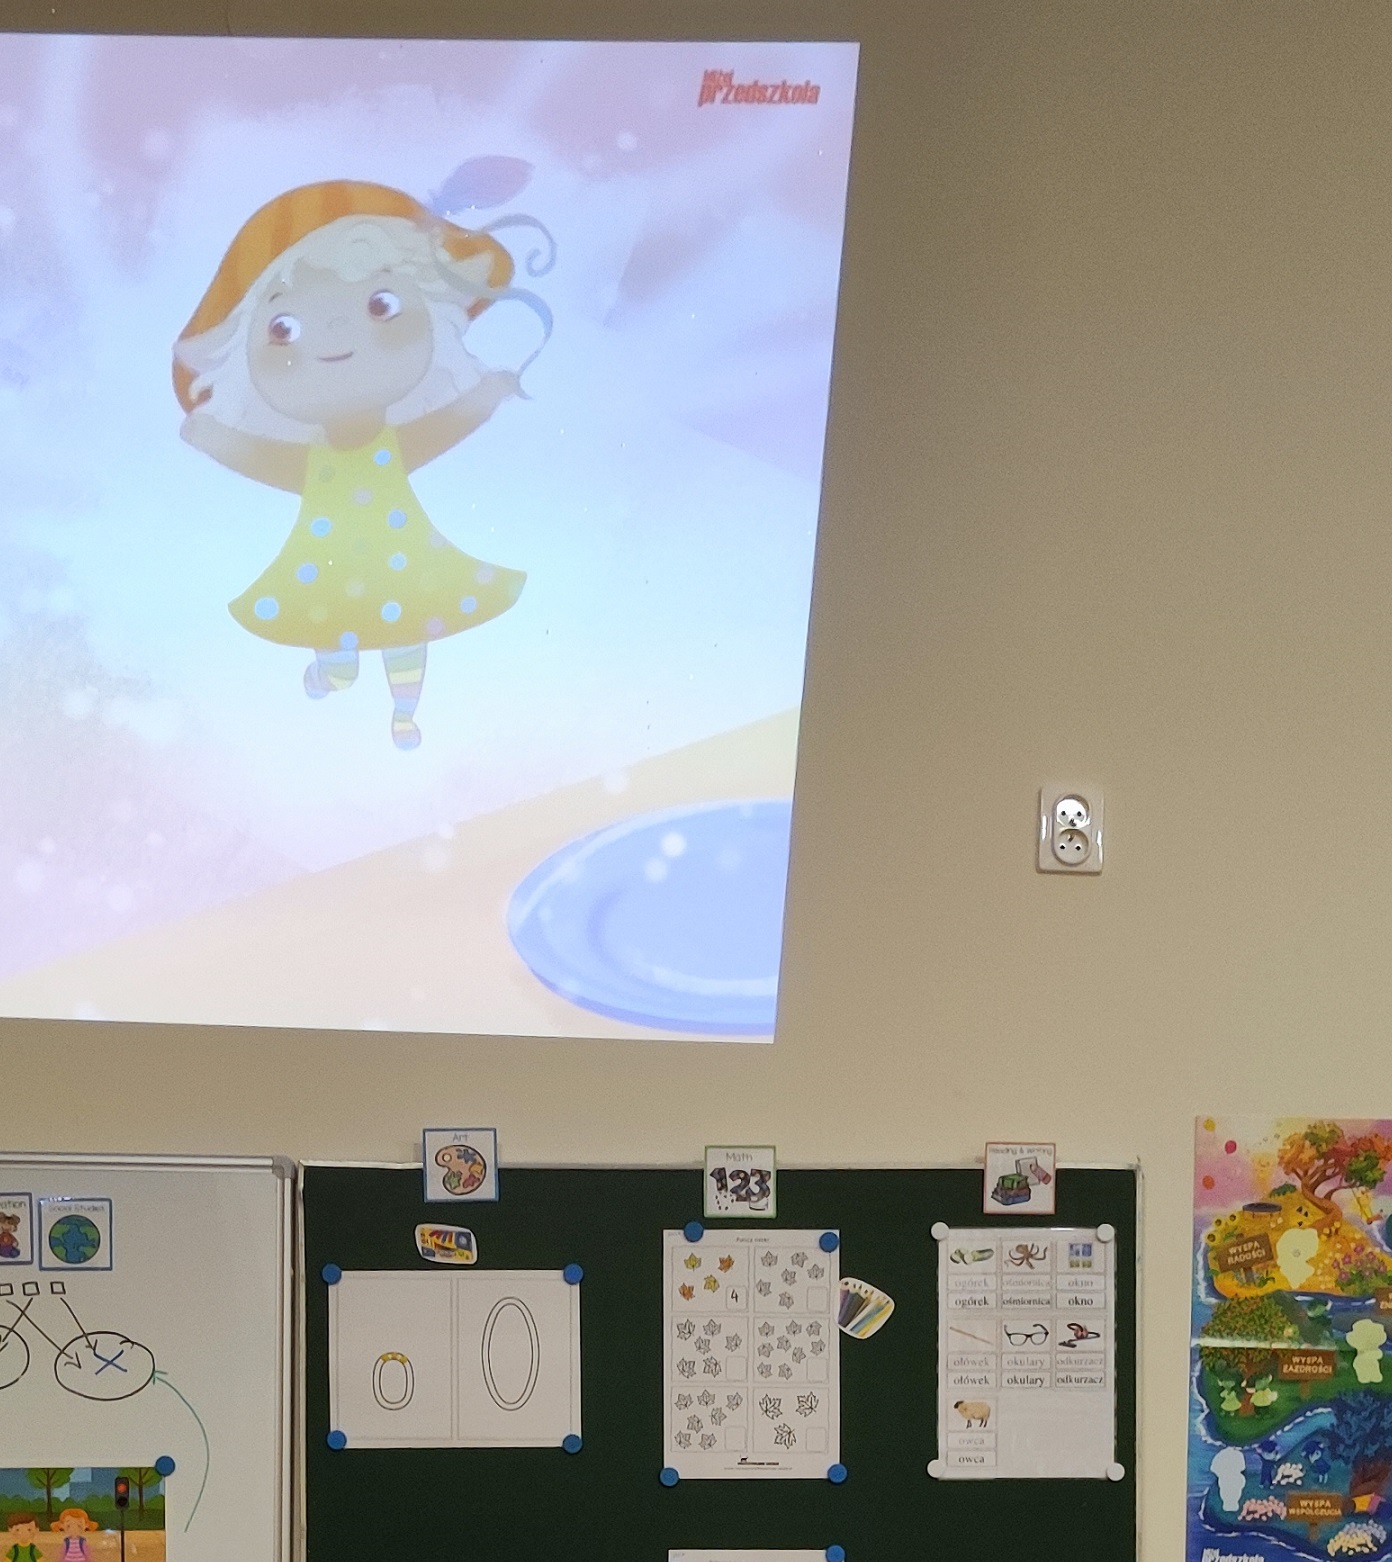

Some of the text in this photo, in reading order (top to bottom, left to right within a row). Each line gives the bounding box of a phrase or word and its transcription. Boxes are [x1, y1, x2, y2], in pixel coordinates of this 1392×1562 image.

[452, 1133, 469, 1142] Art
[726, 1152, 753, 1162] Math
[710, 1167, 771, 1202] 123
[1229, 1240, 1260, 1254] WYSPA
[730, 1289, 739, 1303] 4
[1002, 1296, 1051, 1306] ośmiornica
[1068, 1296, 1093, 1305] okno
[954, 1296, 989, 1308] ogórek
[1007, 1356, 1044, 1368] okulary
[1292, 1356, 1323, 1364] WYSPA
[953, 1375, 990, 1385] ołówek
[1007, 1375, 1045, 1387] okulary
[1057, 1374, 1103, 1384] odkurzacz
[1299, 1500, 1331, 1508] WYSPA
